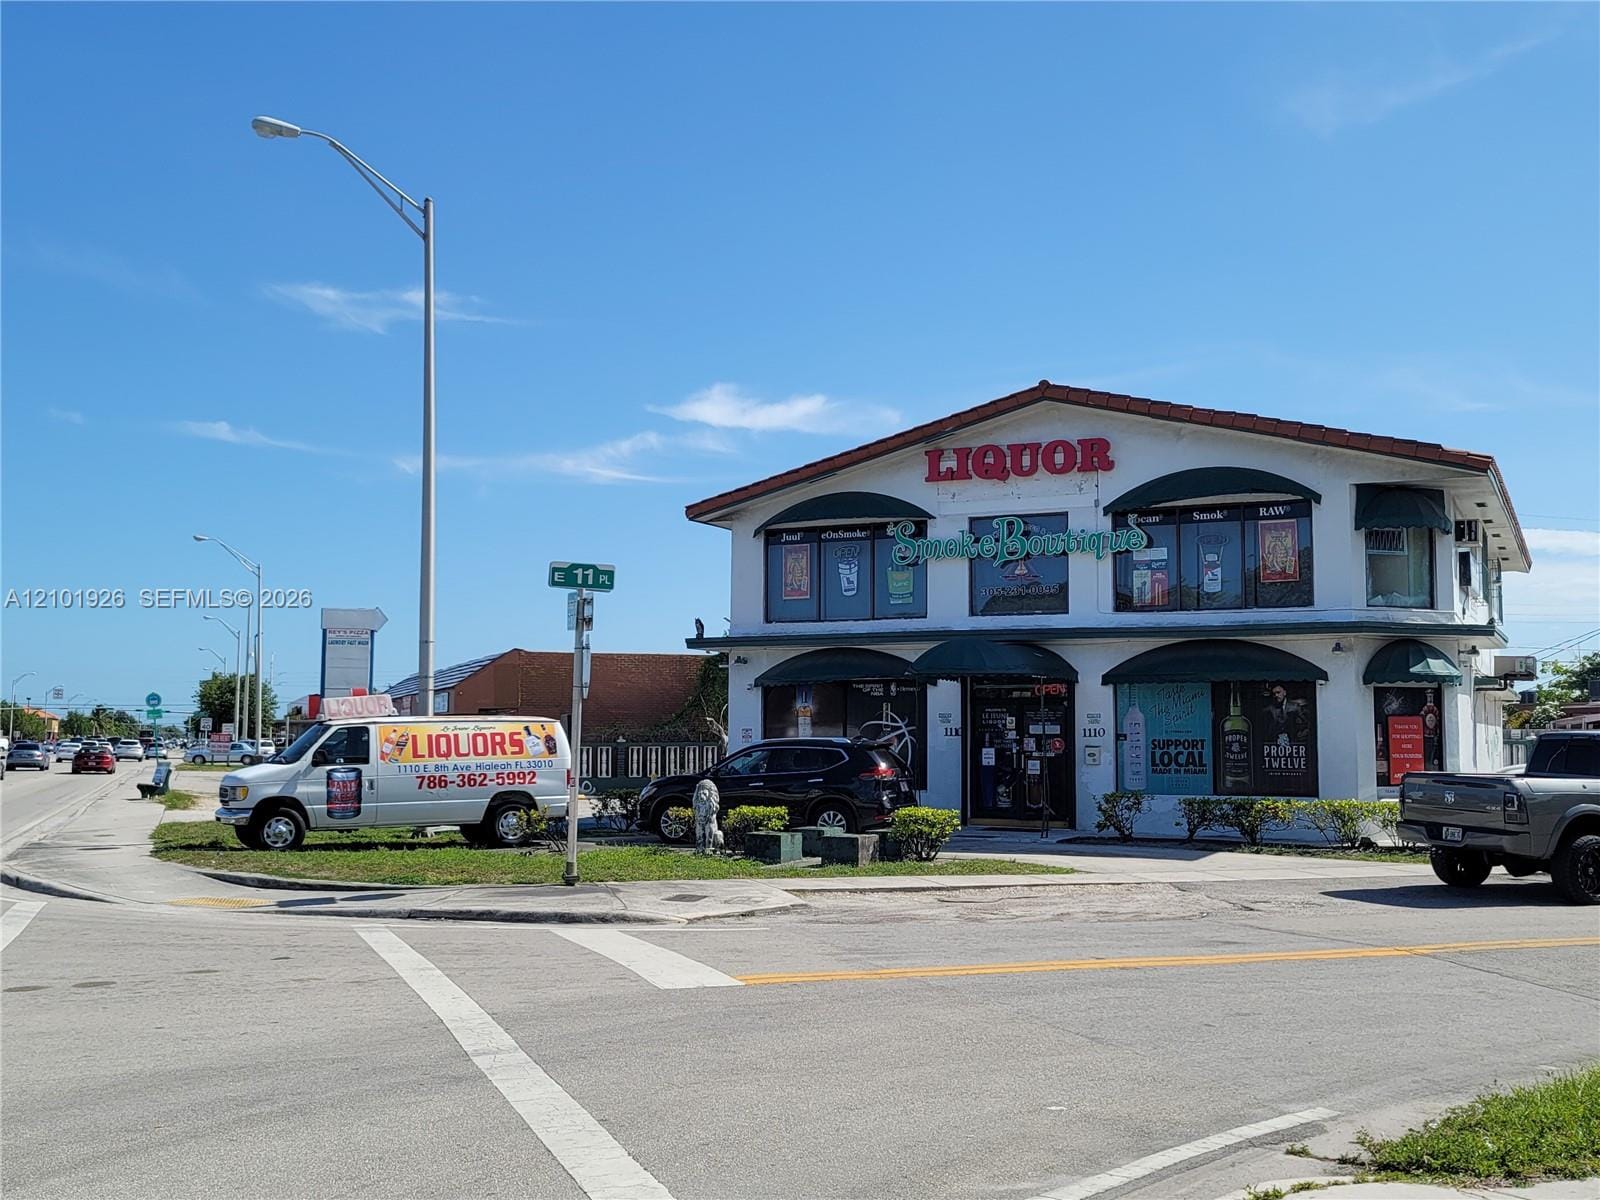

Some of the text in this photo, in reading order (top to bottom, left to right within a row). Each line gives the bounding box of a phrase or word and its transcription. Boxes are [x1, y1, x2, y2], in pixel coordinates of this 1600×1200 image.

[924, 437, 1116, 482] LIQUOR
[887, 514, 1148, 567] Smoke Boutique
[554, 567, 612, 585] E 11 PL
[1035, 683, 1067, 697] OPEN
[1157, 684, 1186, 702] Taste
[327, 695, 388, 717] LIQUOR
[1149, 687, 1208, 719] The Miami
[1164, 704, 1196, 727] Spirit
[1082, 727, 1106, 738] 1110
[1225, 733, 1248, 743] PROPER
[410, 731, 525, 761] LIQUORS
[1151, 738, 1207, 750] SUPPORT
[1263, 745, 1306, 757] PROPER
[397, 764, 420, 773] 1110
[423, 764, 431, 772] E.
[434, 764, 449, 772] 8th
[452, 763, 471, 772] Ave
[475, 761, 512, 771] Hialeah
[1151, 751, 1208, 768] LOCAL
[1264, 757, 1307, 769] TWELVE
[1151, 767, 1208, 775] MADE IN MIAMI
[416, 770, 537, 790] 786-362-5992
